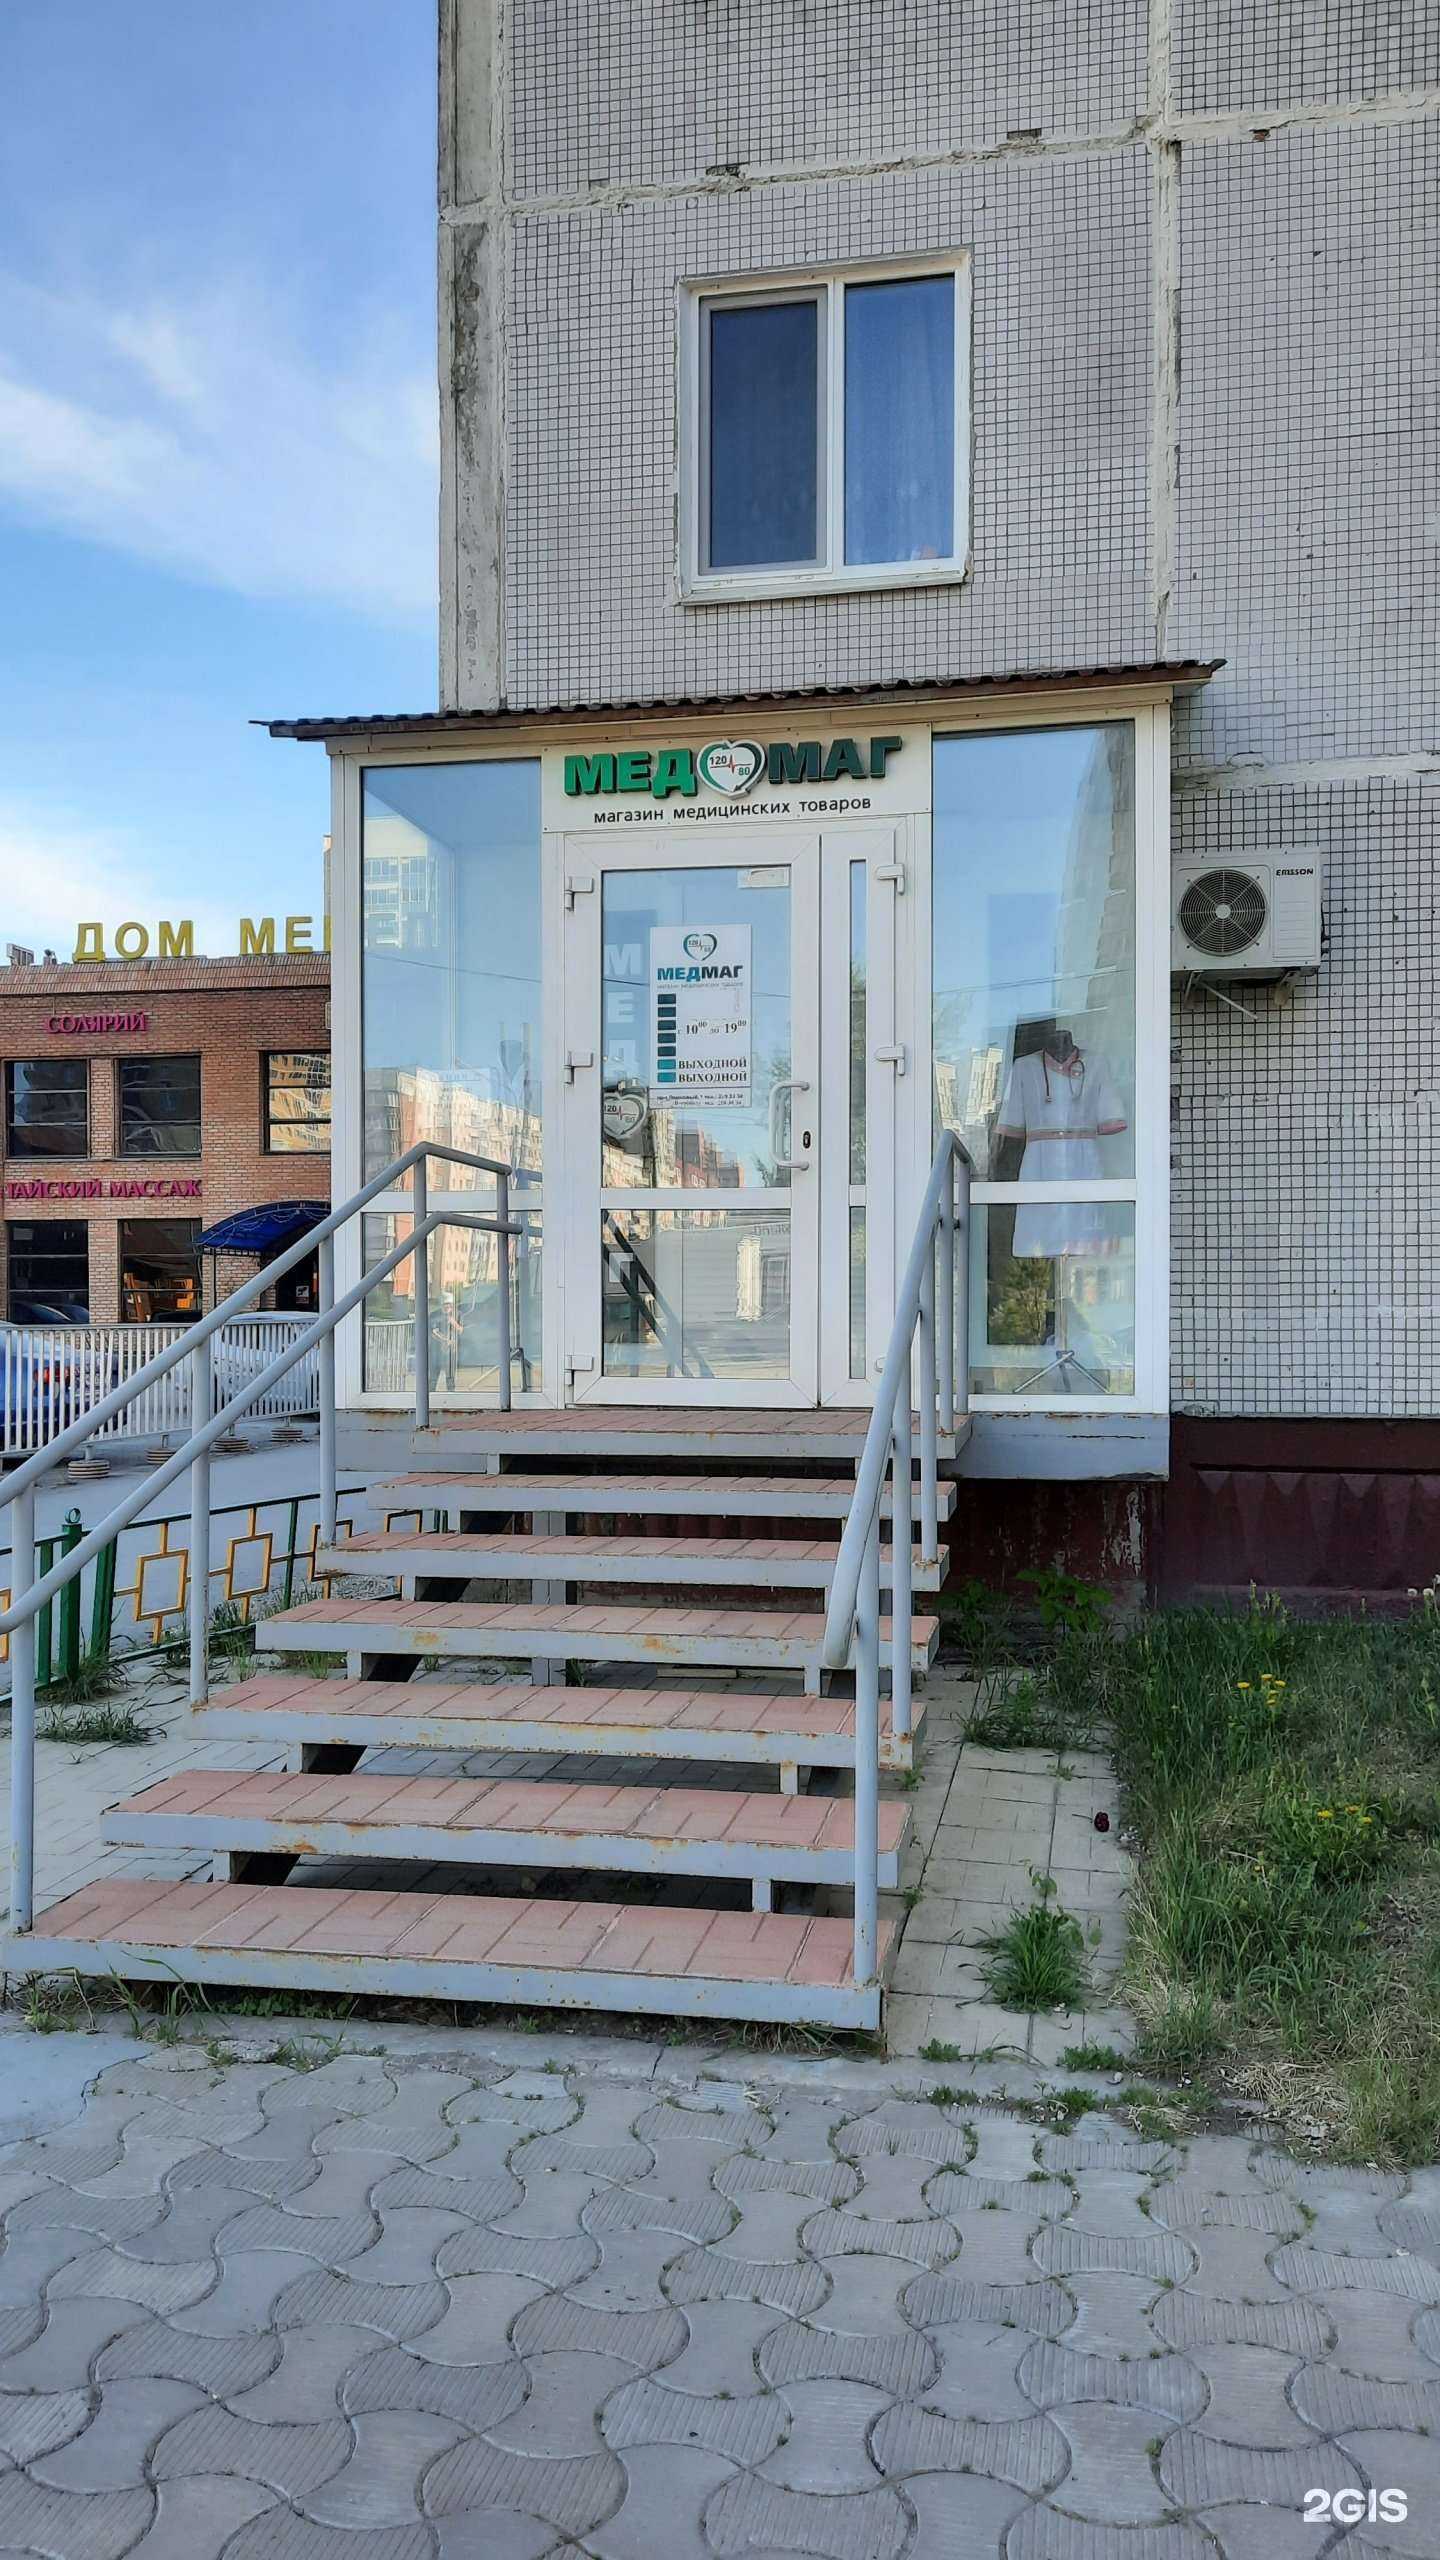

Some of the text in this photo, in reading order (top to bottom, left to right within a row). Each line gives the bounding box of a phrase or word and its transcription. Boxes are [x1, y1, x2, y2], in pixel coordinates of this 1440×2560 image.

[563, 735, 903, 799] МЕД МАГ
[709, 755, 728, 767] 120
[738, 766, 751, 777] 80
[593, 796, 872, 825] магазин медицинских товаров
[73, 916, 332, 963] ДОМ МЕ
[657, 965, 743, 982] МЕДМАГ
[47, 1010, 147, 1034] СОЛЯРИЙ
[678, 1056, 747, 1070] ВЫХОДНОЙ
[678, 1070, 747, 1083] ВЫХОДНОЙ
[111, 1179, 202, 1198] МАССАЖ
